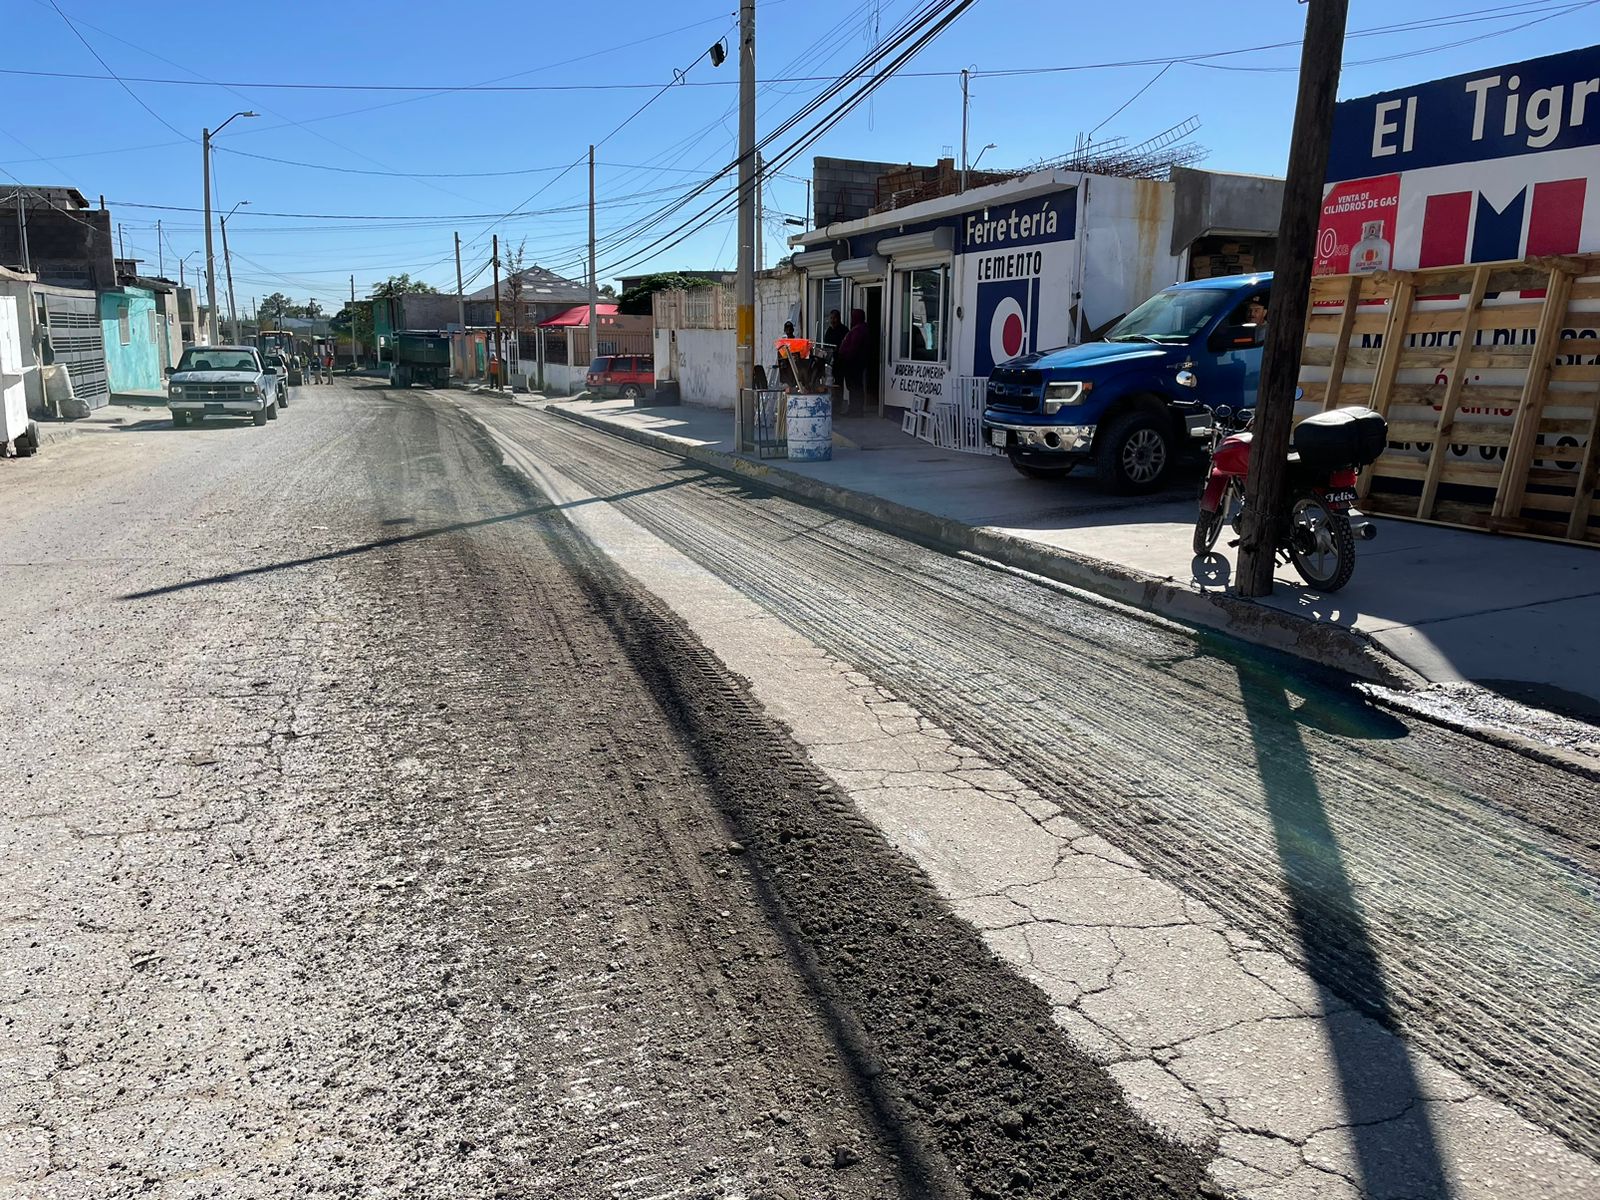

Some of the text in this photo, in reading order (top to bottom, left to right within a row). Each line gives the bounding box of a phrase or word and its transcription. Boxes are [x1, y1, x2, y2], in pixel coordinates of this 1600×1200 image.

[1371, 75, 1600, 158] El Tigr
[1324, 196, 1397, 215] CILINDROS DE GAS
[1338, 192, 1370, 203] VENTA DE
[966, 201, 1058, 246] Ferretería
[890, 377, 897, 389] Y
